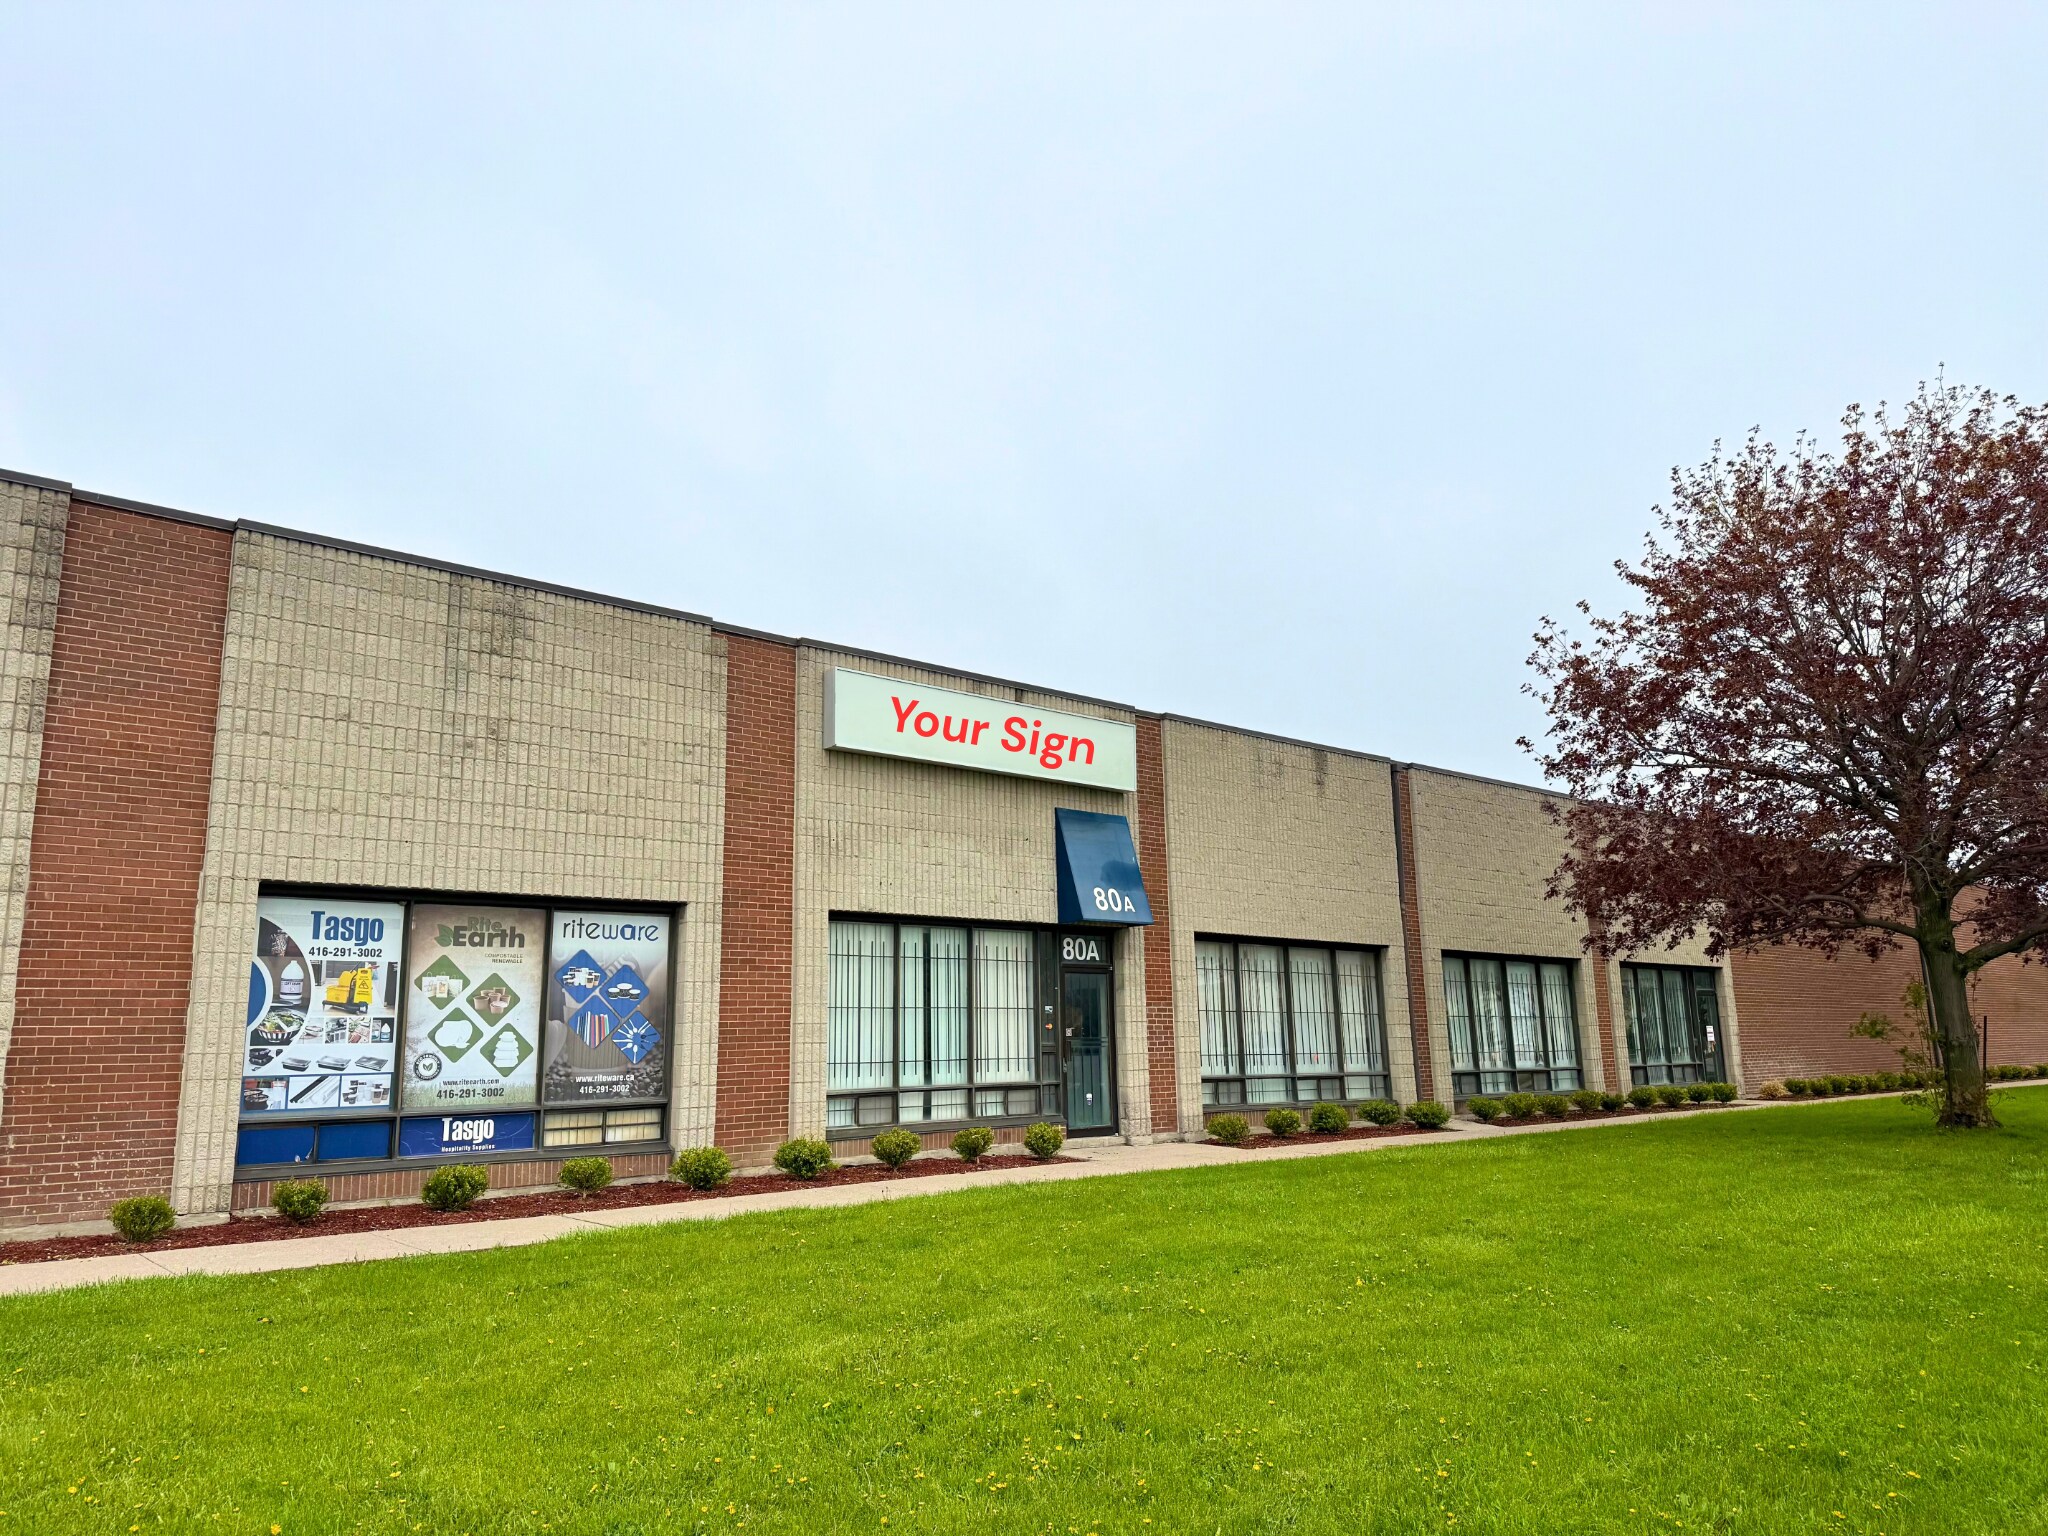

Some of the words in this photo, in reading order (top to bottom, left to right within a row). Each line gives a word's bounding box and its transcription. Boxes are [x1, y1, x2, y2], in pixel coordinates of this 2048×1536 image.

[890, 696, 989, 746] Your
[1000, 716, 1095, 770] Sign
[1093, 887, 1136, 913] 80A
[310, 911, 384, 947] Tasgo
[467, 916, 503, 932] Rite
[562, 917, 659, 941] riteware
[452, 925, 525, 948] Earth
[308, 946, 383, 958] 416-291-3002
[1062, 937, 1100, 961] 80A
[442, 1078, 500, 1087] www.riteearth.com
[575, 1074, 635, 1083] www.riteware.ca
[436, 1087, 505, 1099] 416-291-3002
[579, 1084, 630, 1094] 416-291-3002
[441, 1117, 495, 1144] Tasgo
[441, 1145, 471, 1153] Hospitality
[472, 1143, 496, 1151] Supplies
